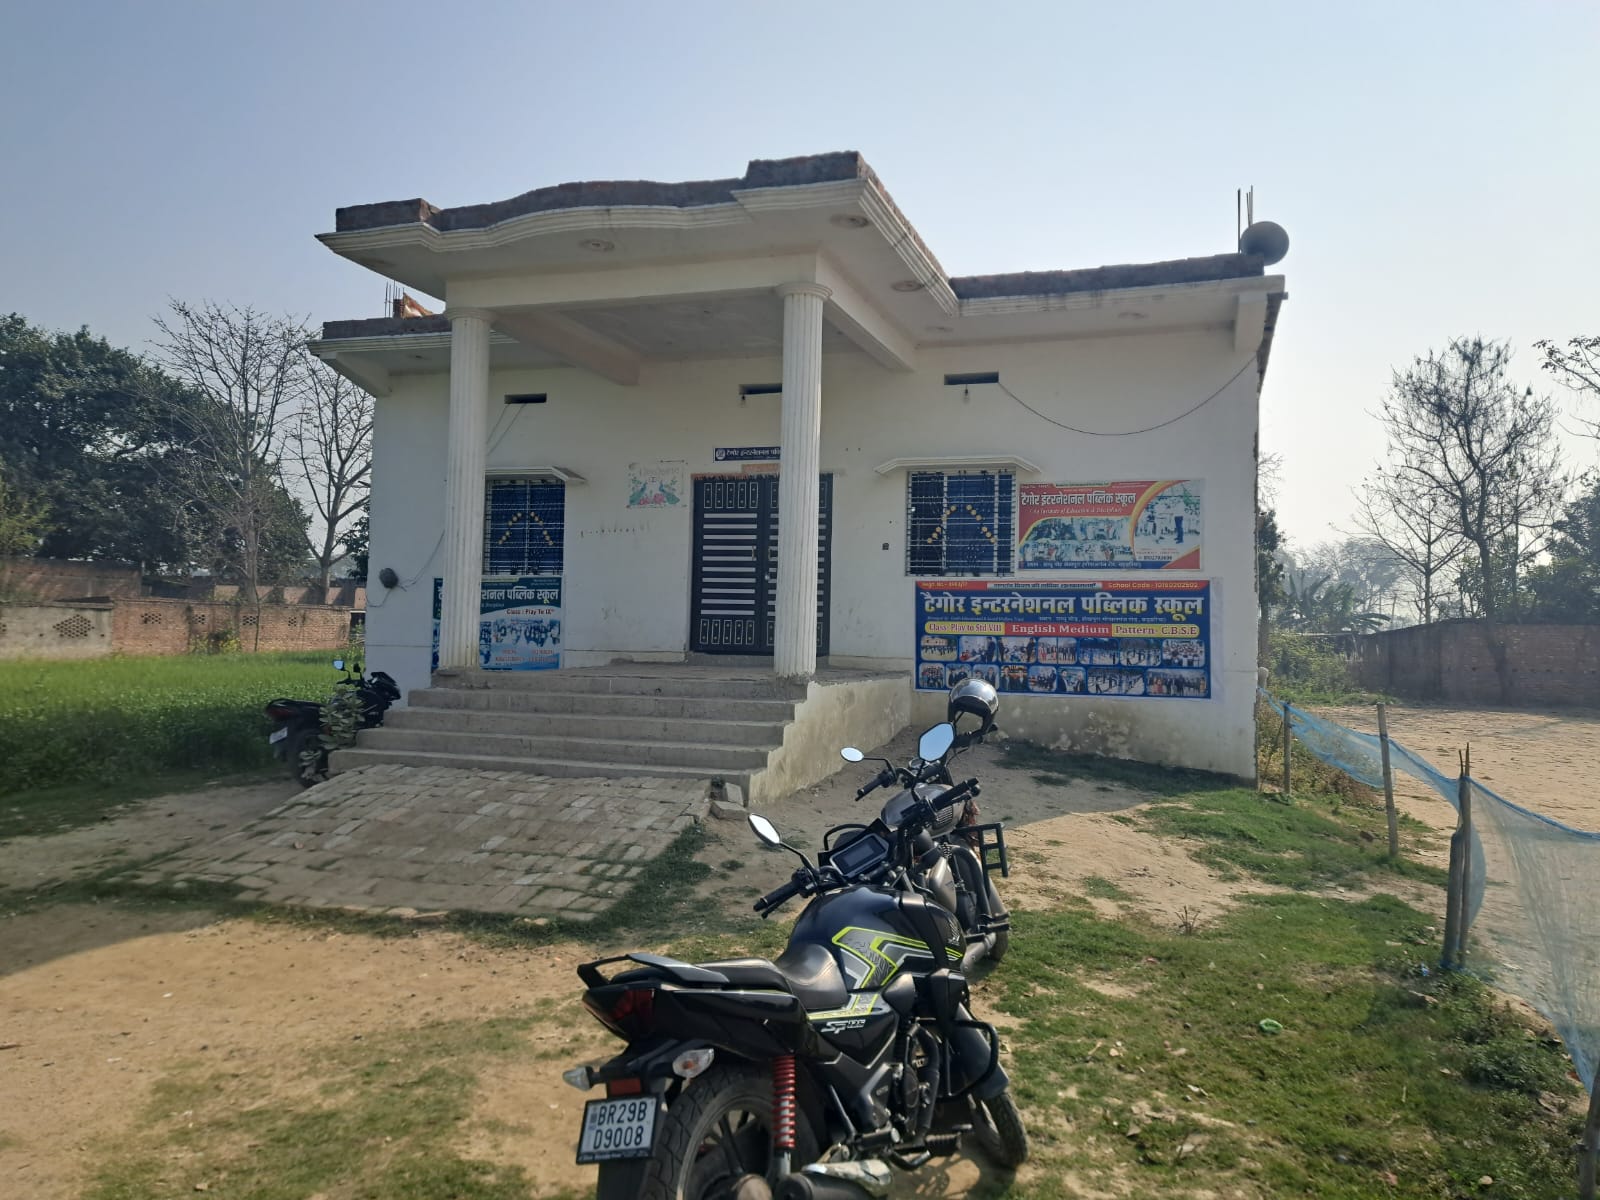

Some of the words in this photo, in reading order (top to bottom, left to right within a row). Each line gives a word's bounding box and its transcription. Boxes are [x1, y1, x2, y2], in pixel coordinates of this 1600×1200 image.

[1020, 491, 1040, 505] टैगोर
[1041, 490, 1085, 506] इंटरनेशनल
[1087, 490, 1114, 504] पब्लिक
[1115, 493, 1136, 507] स्कूल
[507, 585, 535, 600] पब्लिक
[536, 588, 559, 604] स्कूल
[920, 591, 966, 613] टैगोर
[970, 591, 1077, 615] इन्टरनेशनल
[1080, 592, 1149, 614] पब्लिक
[1154, 596, 1204, 621] स्कूल
[951, 623, 966, 633] Play
[967, 624, 974, 632] to
[976, 623, 987, 632] Std
[1012, 624, 1056, 635] English
[1060, 624, 1109, 634] Medium
[598, 1101, 647, 1126] BR29B
[593, 1125, 644, 1149] D9008
